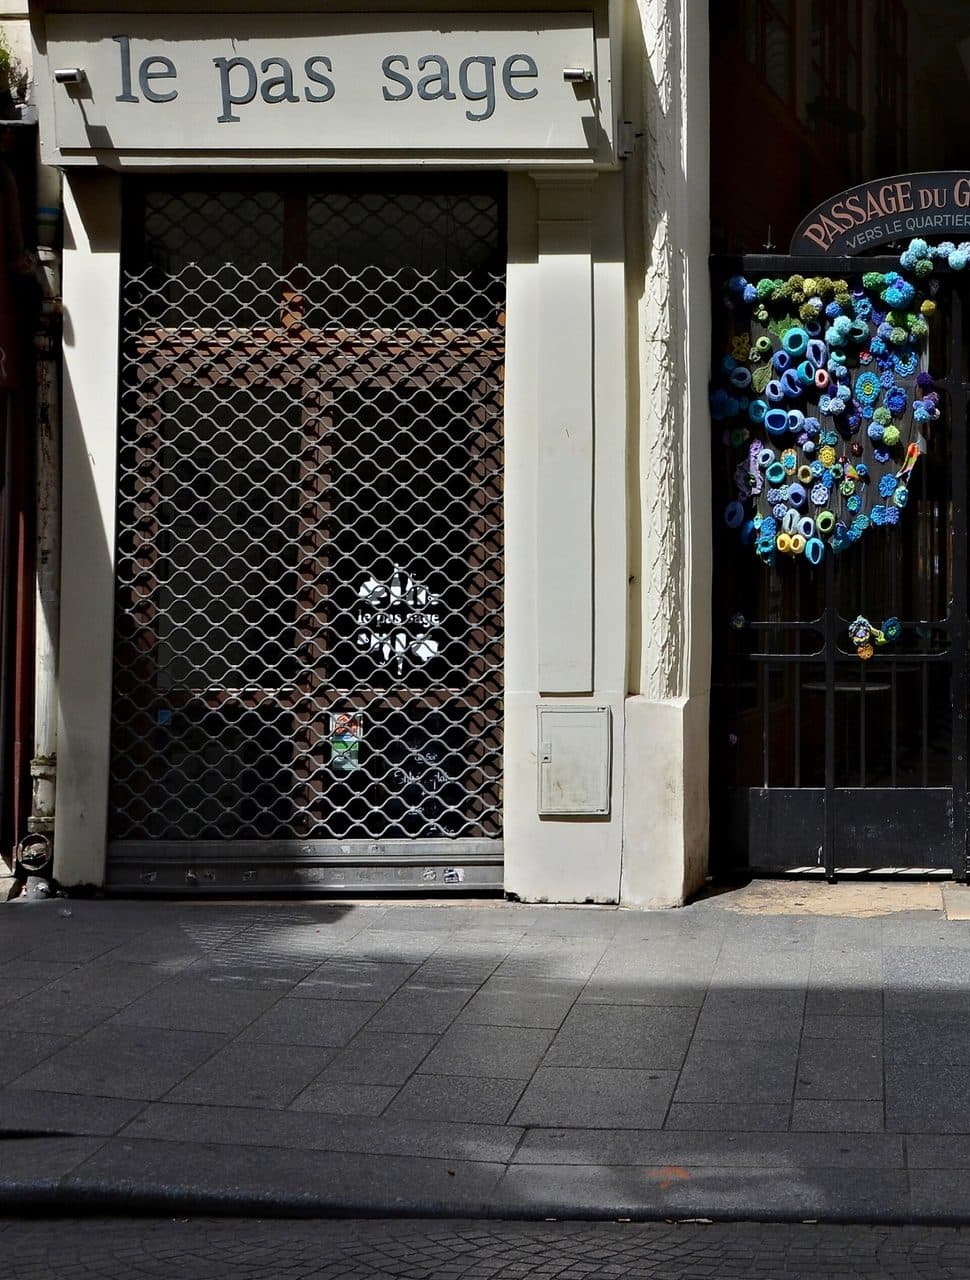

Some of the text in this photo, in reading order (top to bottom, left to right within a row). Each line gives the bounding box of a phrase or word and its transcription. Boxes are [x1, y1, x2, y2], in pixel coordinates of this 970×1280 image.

[111, 34, 539, 123] le pas sage
[803, 181, 914, 252] PASSAGE
[918, 188, 947, 210] DU
[846, 225, 883, 250] VERS
[885, 220, 902, 235] LE
